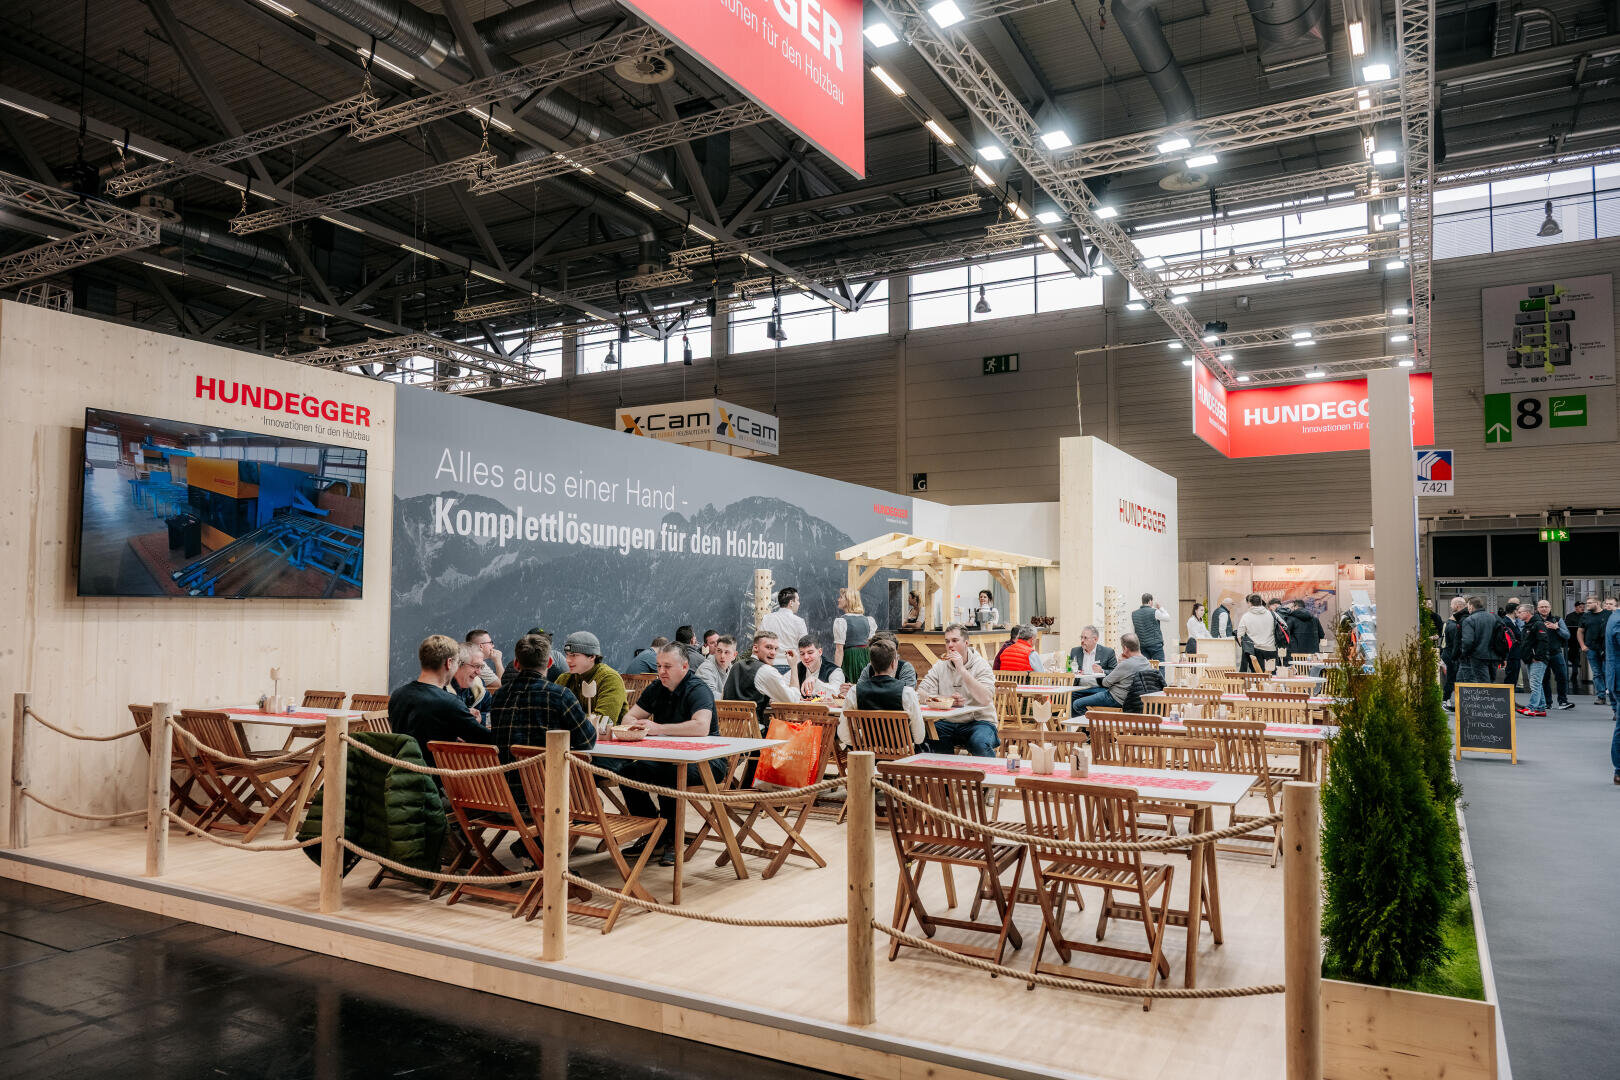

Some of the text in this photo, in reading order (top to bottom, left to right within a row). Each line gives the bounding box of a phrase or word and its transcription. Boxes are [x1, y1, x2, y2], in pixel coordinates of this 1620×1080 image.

[762, 17, 779, 48] für
[781, 37, 803, 71] den
[805, 53, 844, 105] Holzbau
[195, 375, 371, 428] HUNDEGGER
[1197, 380, 1227, 424] HUNDEGGER
[1516, 398, 1543, 429] 8
[263, 415, 371, 442] Innovationen für den Holzbau
[1302, 423, 1351, 434] Innovationen
[1353, 420, 1364, 430] für
[435, 447, 505, 488] Alles
[513, 468, 557, 496] aus
[564, 470, 620, 503] einer
[626, 478, 676, 511] Hand
[1421, 482, 1448, 493] 7.421
[435, 496, 785, 562] Komplettlösungen für den Holzbau
[1119, 498, 1167, 534] HUNDEGGER
